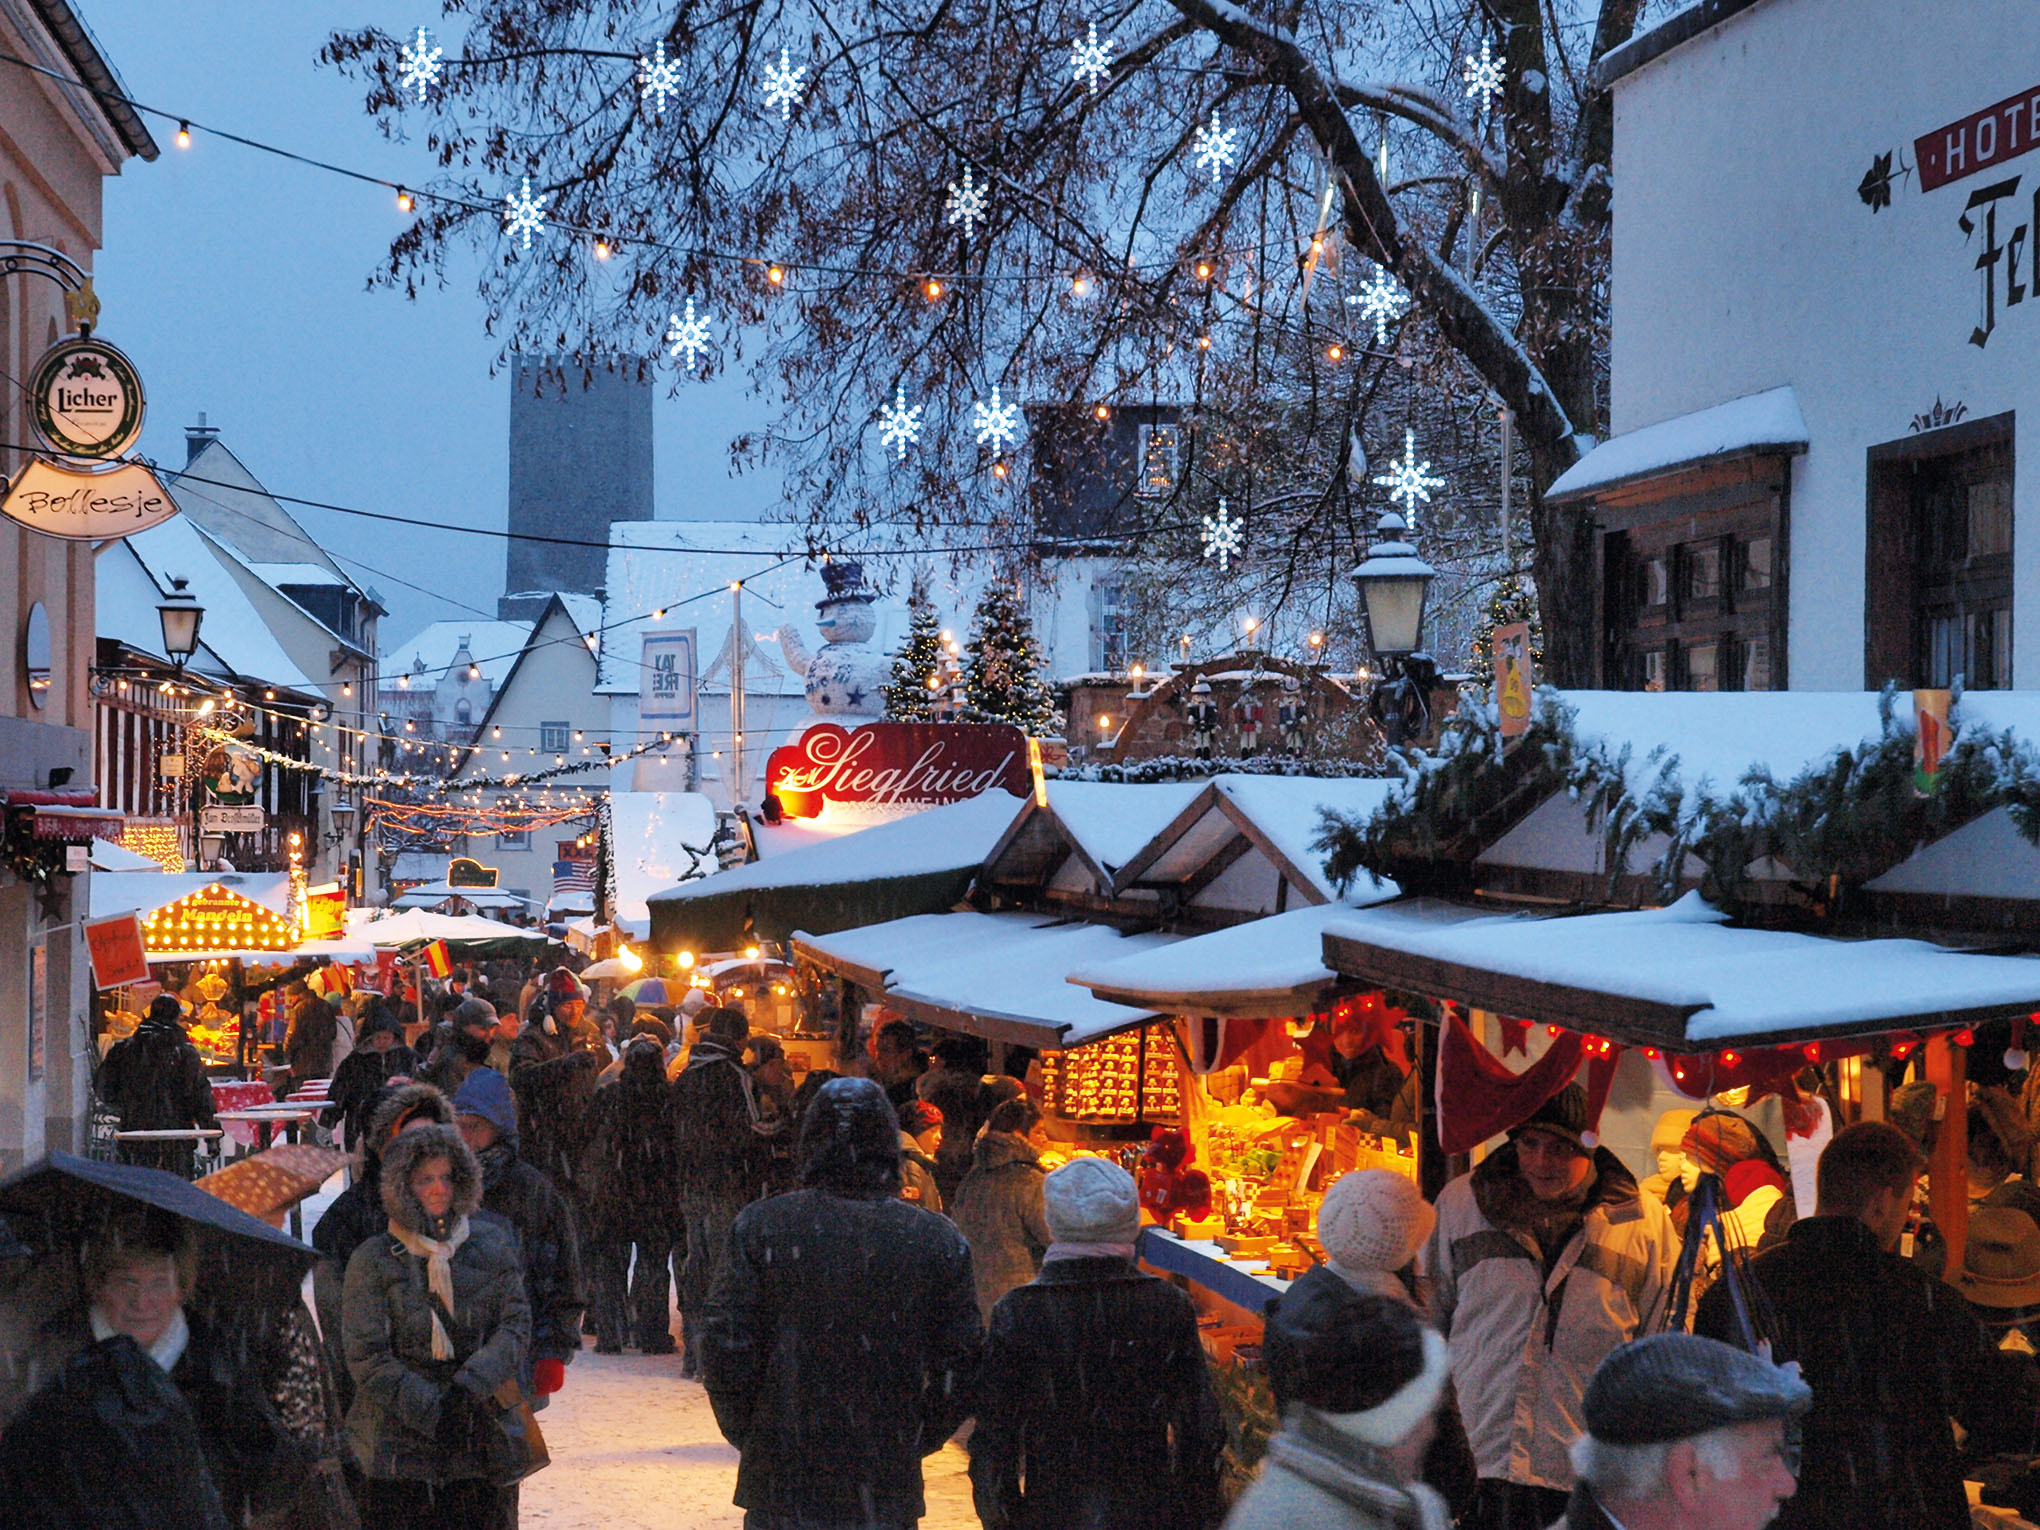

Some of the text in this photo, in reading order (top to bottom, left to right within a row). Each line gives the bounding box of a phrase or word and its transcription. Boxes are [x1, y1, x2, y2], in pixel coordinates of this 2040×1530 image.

[57, 387, 118, 413] Licher
[19, 488, 162, 518] Bollesje
[778, 731, 1016, 806] Siegfried
[191, 897, 240, 907] gebrannte
[180, 908, 253, 923] Mandeln
